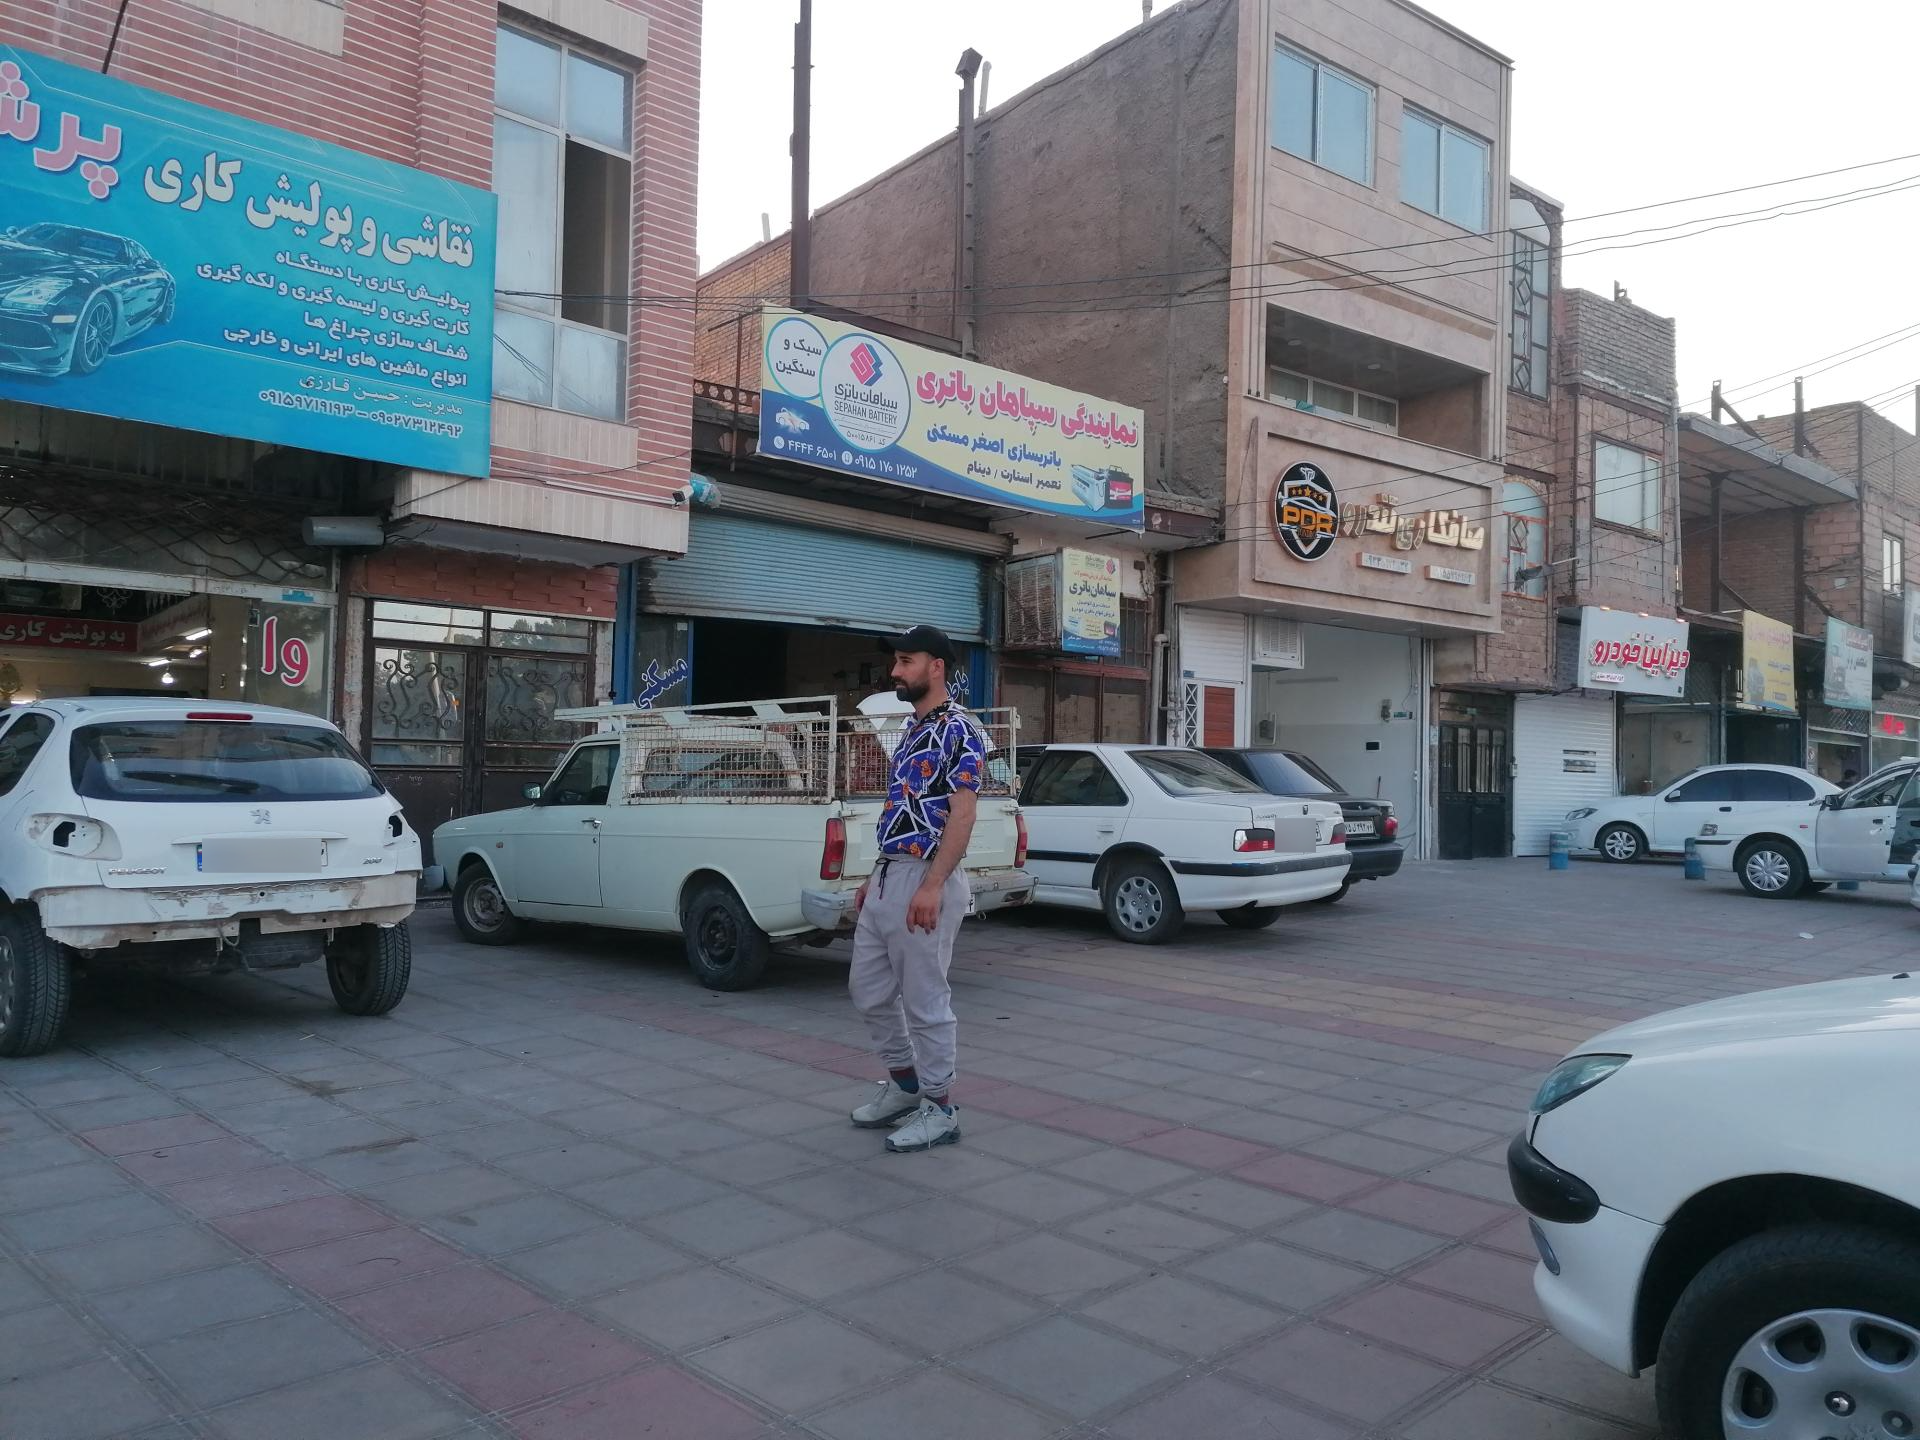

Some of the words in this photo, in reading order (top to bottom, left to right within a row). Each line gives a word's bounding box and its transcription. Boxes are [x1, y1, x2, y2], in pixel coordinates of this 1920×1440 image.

[144, 151, 242, 212] کاری
[246, 173, 354, 253] پولیش
[356, 216, 377, 257] و
[382, 215, 474, 268] نقاشی
[196, 262, 242, 284] گیری
[275, 250, 344, 278] دستگاه
[244, 271, 275, 290] لکه
[347, 265, 362, 284] با
[277, 282, 288, 296] و
[365, 277, 405, 294] کاری
[291, 287, 333, 305] گیری
[336, 294, 377, 315] لیسه
[407, 284, 471, 316] پولیش
[303, 311, 327, 330] ها
[379, 306, 389, 320] و
[391, 309, 430, 328] گیری
[223, 326, 277, 346] خارجی
[328, 318, 371, 345] چراغ
[432, 316, 471, 336] کارت
[279, 337, 290, 352] و
[373, 330, 415, 350] سازی
[783, 338, 790, 350] و
[793, 338, 822, 356] سبک
[293, 341, 343, 362] ایرانی
[346, 353, 377, 369] های
[417, 341, 469, 361] شفاف
[379, 358, 428, 378] ماشین
[430, 367, 467, 388] انواع
[775, 358, 816, 378] سنگین
[352, 386, 400, 402] حسین
[834, 383, 859, 405] باتری
[859, 387, 898, 411] سپاهان
[916, 369, 974, 414] باتری
[411, 394, 463, 416] مدیریت
[834, 400, 868, 419] SEPAHAN
[868, 407, 898, 425] BATTERY
[979, 380, 1056, 436] سپاهان
[926, 423, 970, 447] مسکنی
[1060, 402, 1139, 449] نمایندگی
[788, 439, 814, 455] ۴۴۴۴
[971, 432, 1004, 454] اصغر
[855, 454, 876, 470] ۰۹۱۵
[966, 460, 992, 477] دینام
[1000, 466, 1033, 485] استارت
[1036, 475, 1062, 491] تعمیر
[1283, 505, 1333, 535] PDR
[1069, 580, 1091, 597] باتری
[1091, 582, 1117, 601] سپاهان
[0, 620, 47, 642] کاری
[49, 623, 106, 647] پولیش
